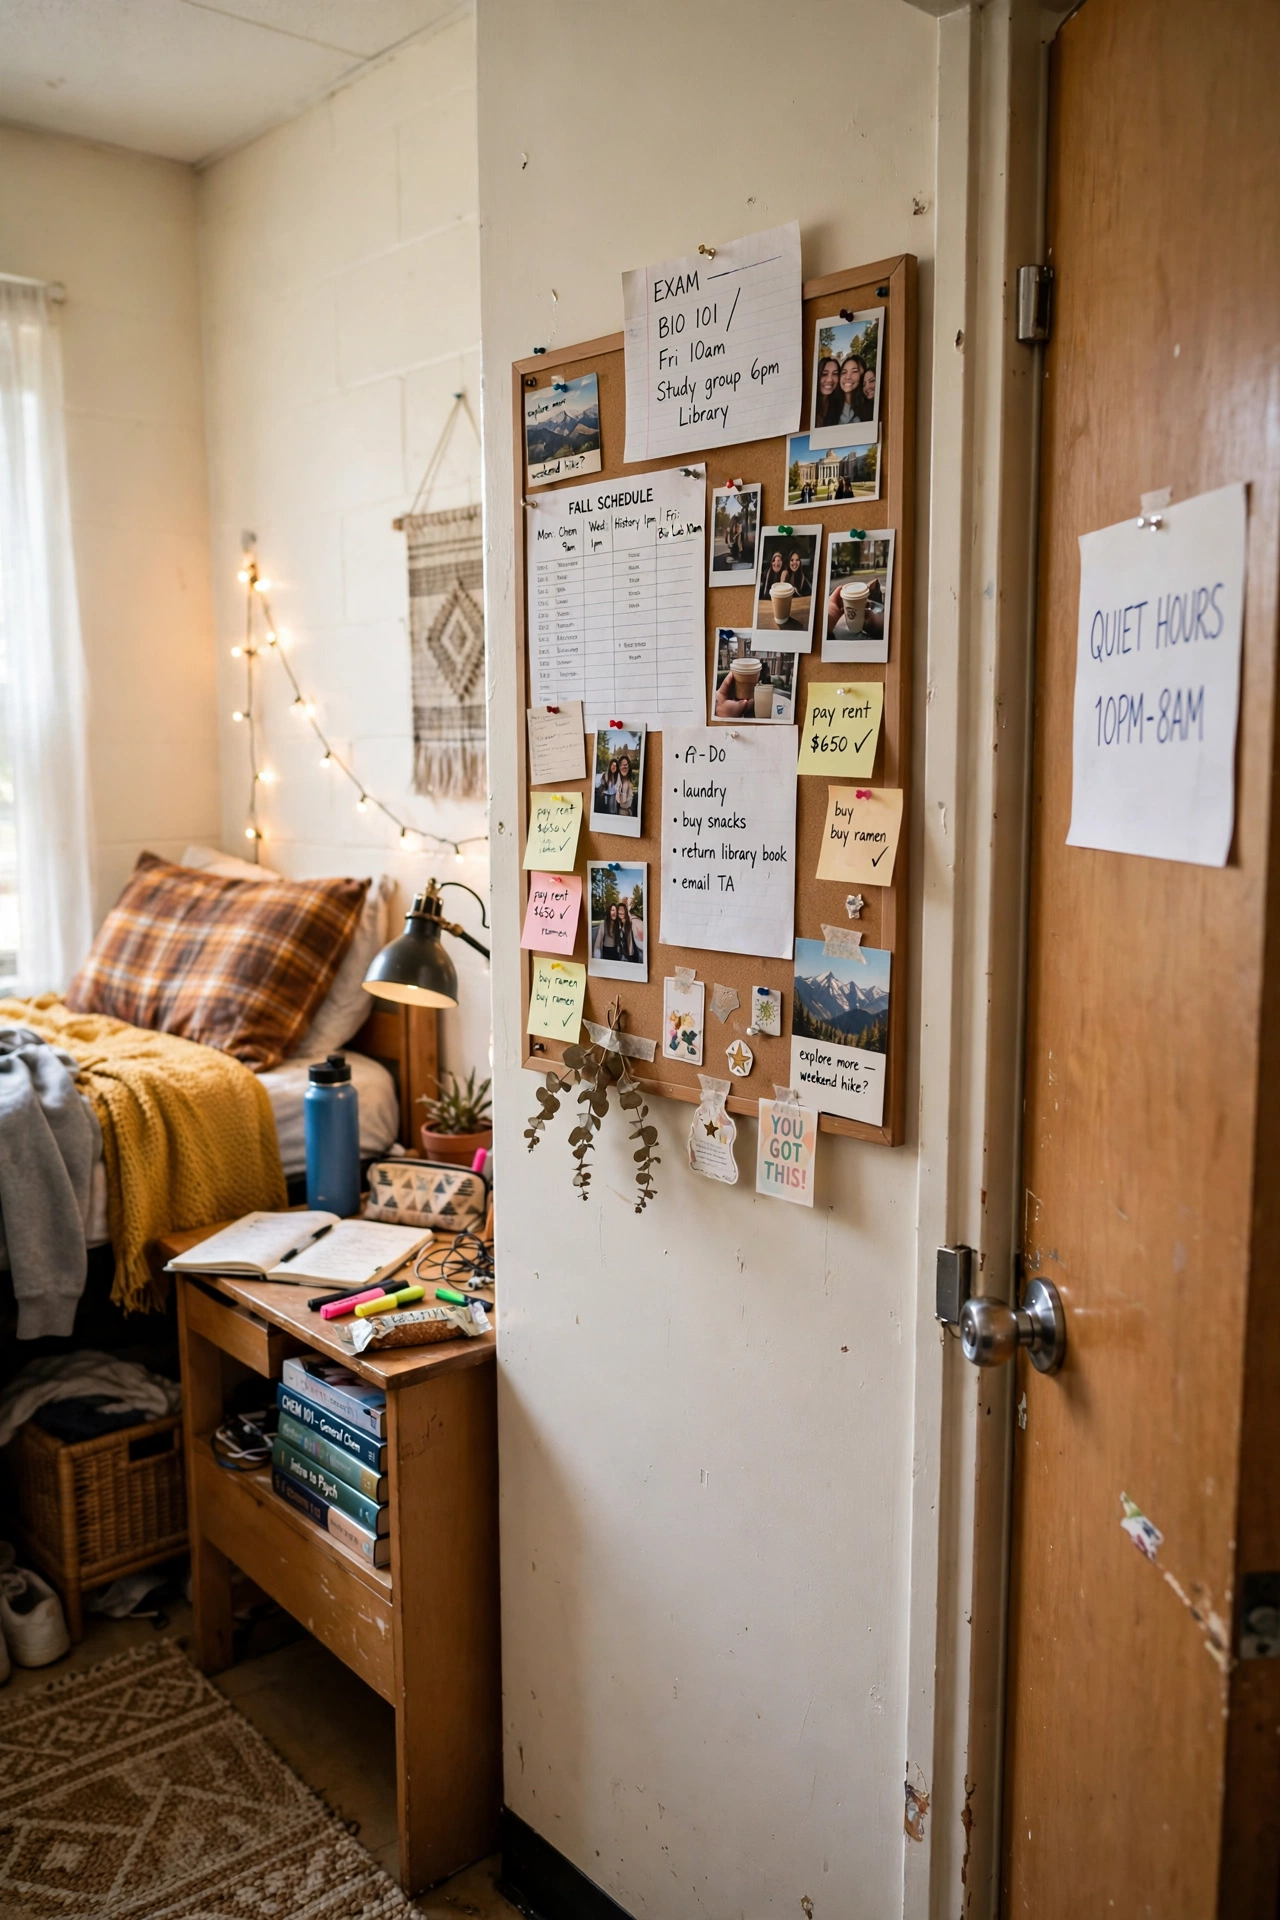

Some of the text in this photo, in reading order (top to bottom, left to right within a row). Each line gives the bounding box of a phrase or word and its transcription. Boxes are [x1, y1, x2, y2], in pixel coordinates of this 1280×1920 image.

[654, 271, 699, 303] EXAM
[659, 313, 685, 340] BIO
[696, 303, 717, 328] 101
[659, 340, 725, 370] Fri 10am
[657, 357, 780, 402] Study group 6pm
[679, 405, 729, 429] Library
[569, 488, 654, 515] FALL SCHEDULE
[614, 517, 640, 531] History
[1090, 582, 1225, 662] QUIET HOURS
[812, 701, 872, 727] pay rent
[1095, 685, 1205, 747] 10PM-8AM
[810, 733, 848, 753] $650
[683, 780, 727, 806] laundry
[556, 804, 575, 815] rent
[834, 801, 854, 825] buy
[682, 811, 747, 835] buy snacks
[830, 824, 886, 847] buy ramen
[682, 842, 788, 868] return library book
[682, 873, 735, 892] email TA
[534, 890, 568, 904] pay rent
[539, 970, 551, 989] buy
[536, 989, 549, 1007] buy
[800, 1048, 832, 1067] explore
[836, 1059, 860, 1071] more
[800, 1070, 868, 1094] weekend hike?
[771, 1114, 803, 1139] YOU
[770, 1138, 802, 1163] GOT
[764, 1161, 806, 1190] THIS!
[282, 1395, 302, 1418] CHEM
[320, 1419, 343, 1442] General
[344, 1433, 360, 1453] Chem
[318, 1474, 338, 1500] Psych
